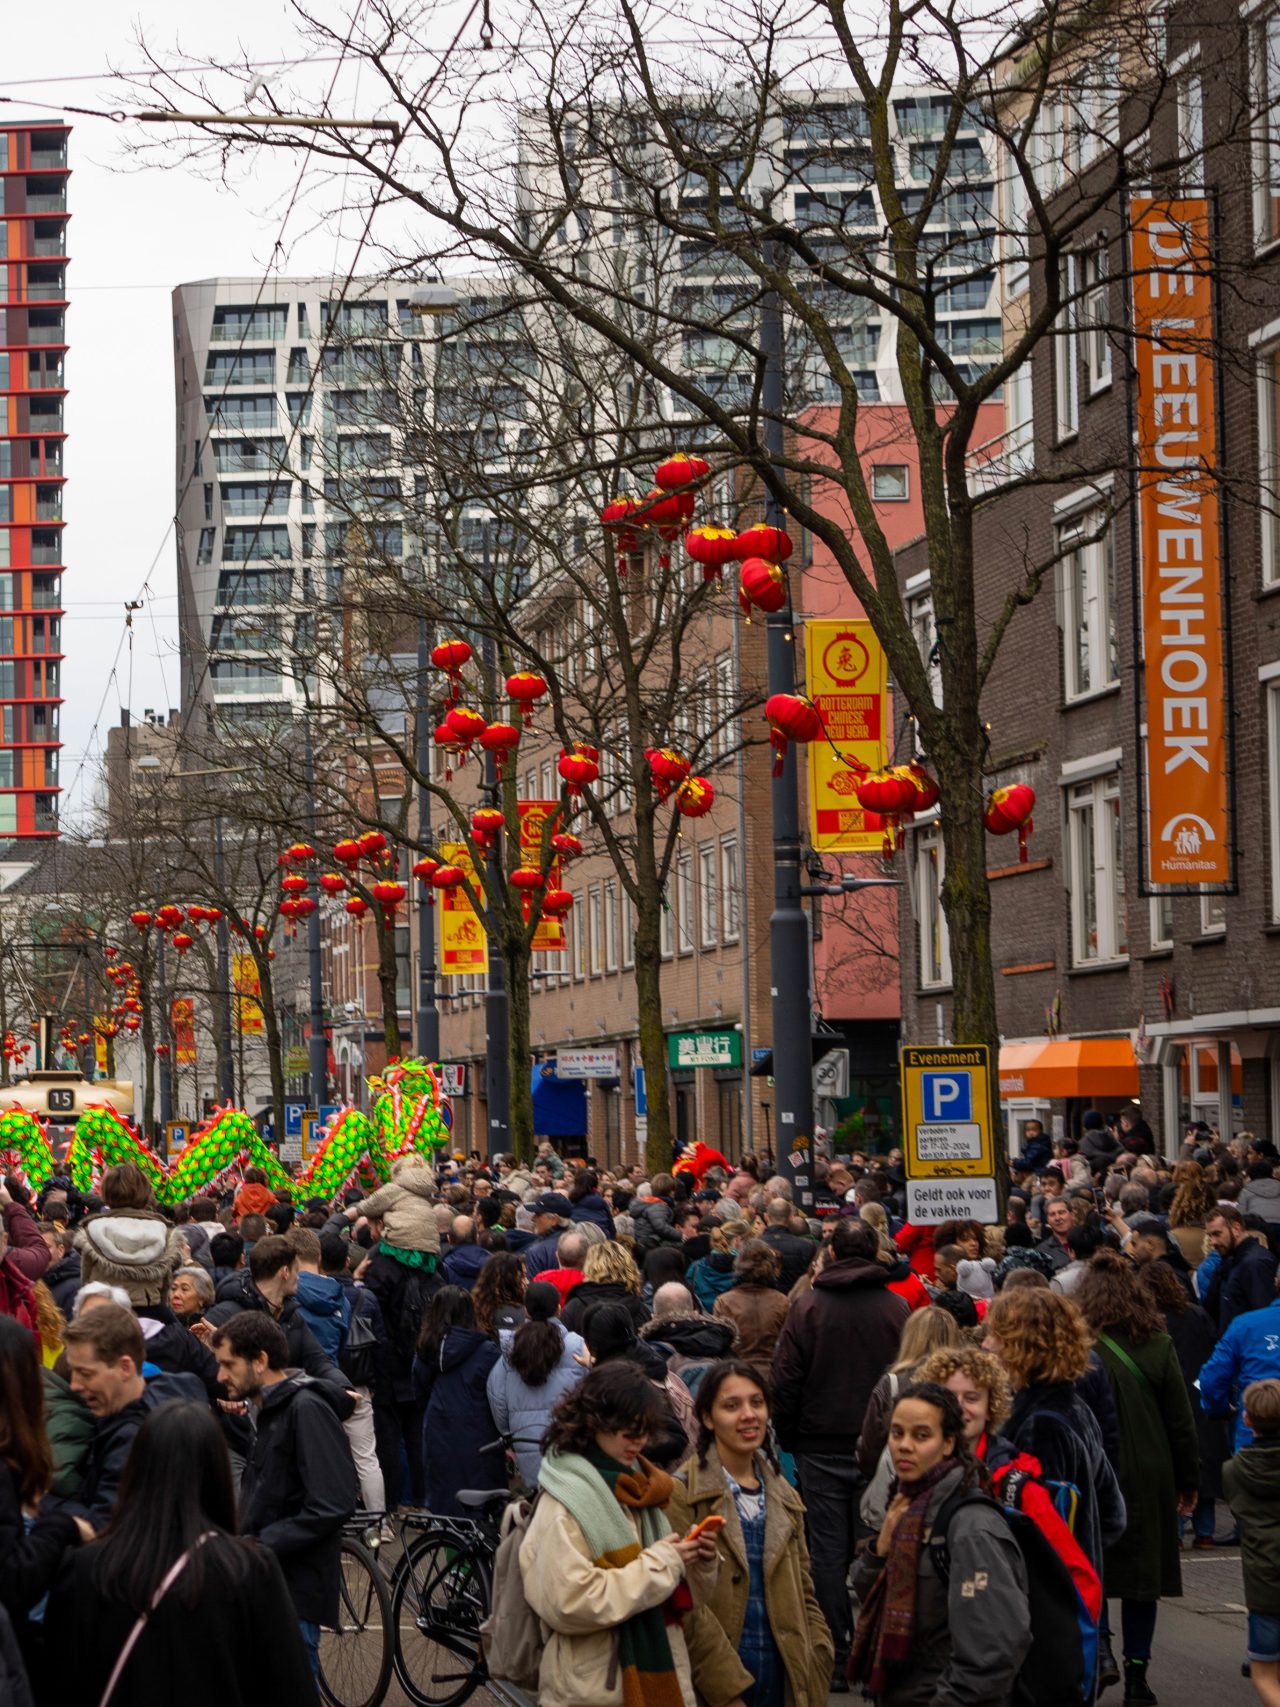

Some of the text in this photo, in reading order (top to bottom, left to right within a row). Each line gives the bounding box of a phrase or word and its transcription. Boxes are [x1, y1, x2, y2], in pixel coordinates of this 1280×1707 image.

[1148, 222, 1210, 775] DE LEEUWENHOEK
[820, 696, 873, 711] ROTTERDAM
[828, 711, 865, 725] CHINESE
[824, 725, 870, 739] NEW YEAR
[1161, 859, 1217, 871] Humanitas
[678, 1035, 731, 1055] 美豐行
[910, 1051, 981, 1065] Evenement
[52, 1092, 71, 1106] 15
[933, 1078, 960, 1117] P
[289, 1106, 301, 1124] P
[914, 1188, 992, 1201] Geldt ook voor
[914, 1205, 972, 1218] de vakken
